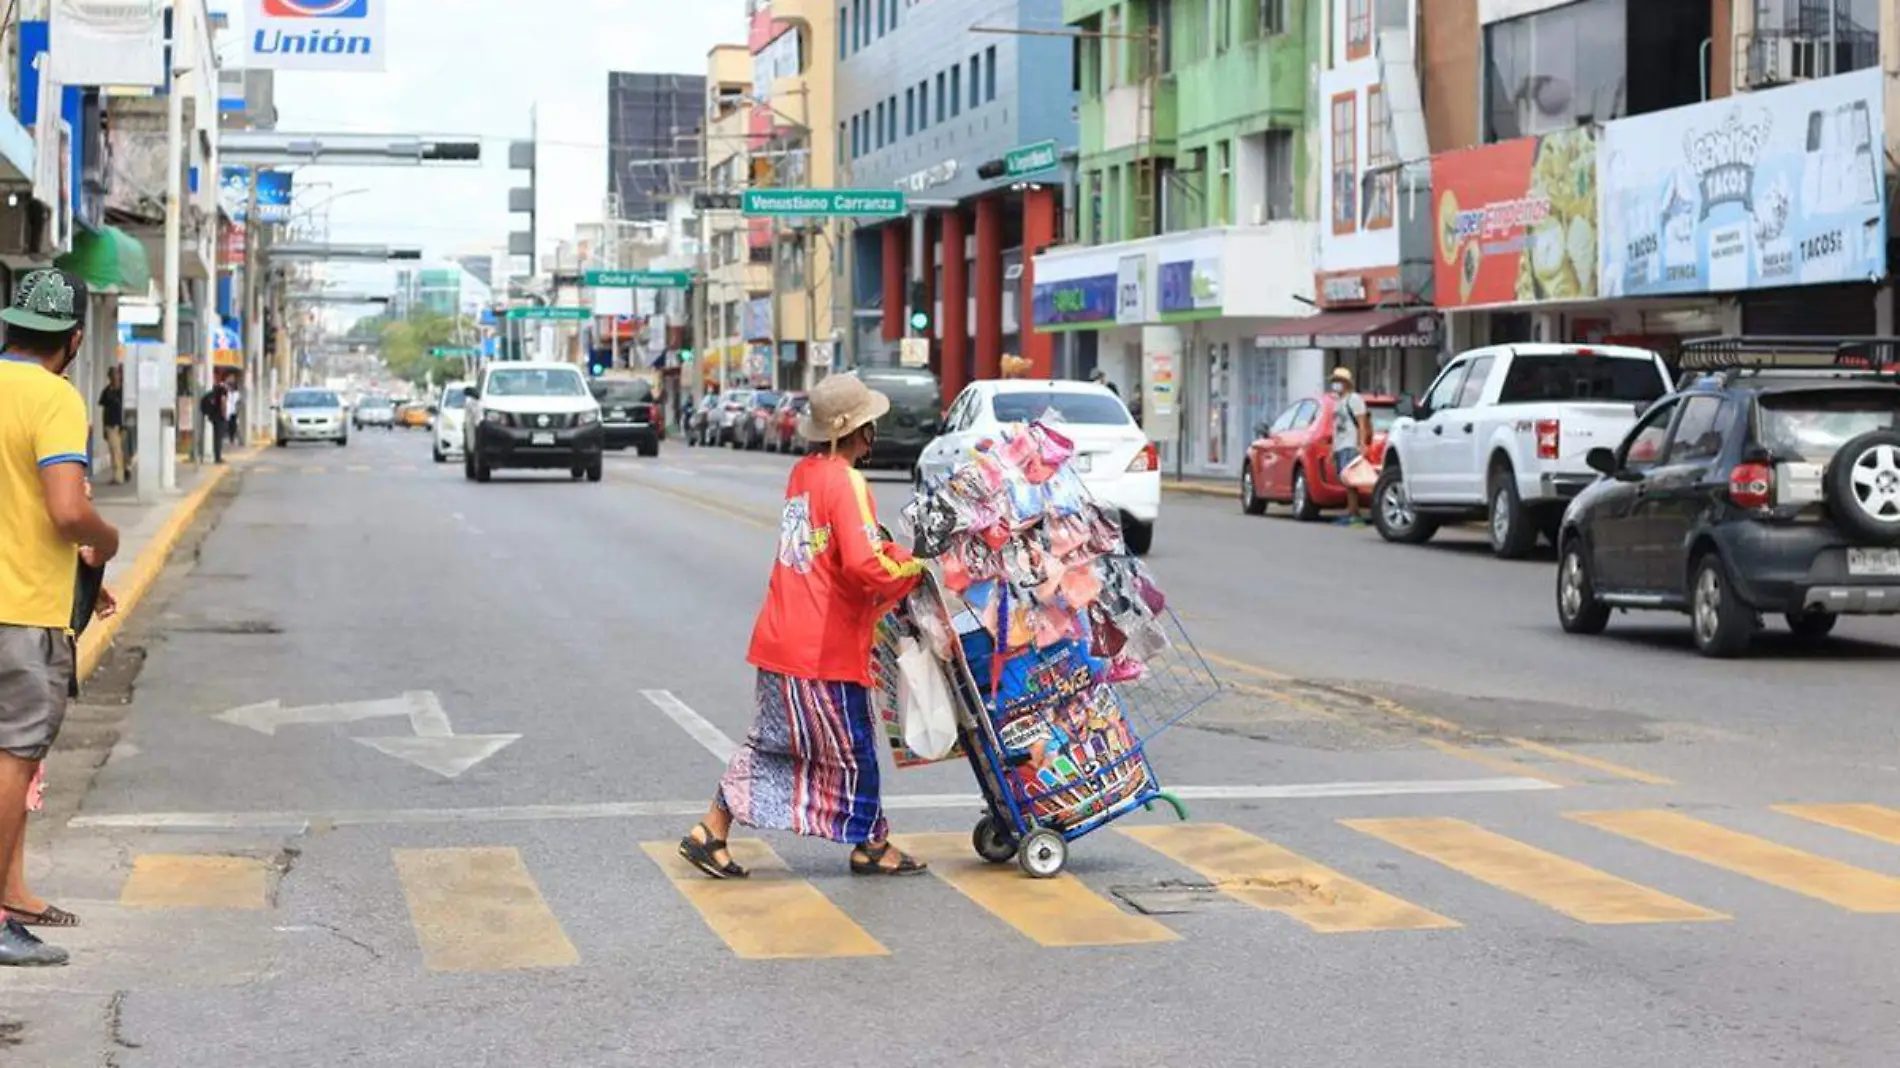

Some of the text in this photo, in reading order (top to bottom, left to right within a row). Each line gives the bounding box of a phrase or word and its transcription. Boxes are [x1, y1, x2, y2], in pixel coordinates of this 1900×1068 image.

[253, 28, 372, 54] Unión
[1706, 168, 1748, 201] TACOS
[751, 194, 897, 210] Venustiano Carranza
[1627, 232, 1658, 262] TACOS
[1800, 230, 1836, 262] TACOS
